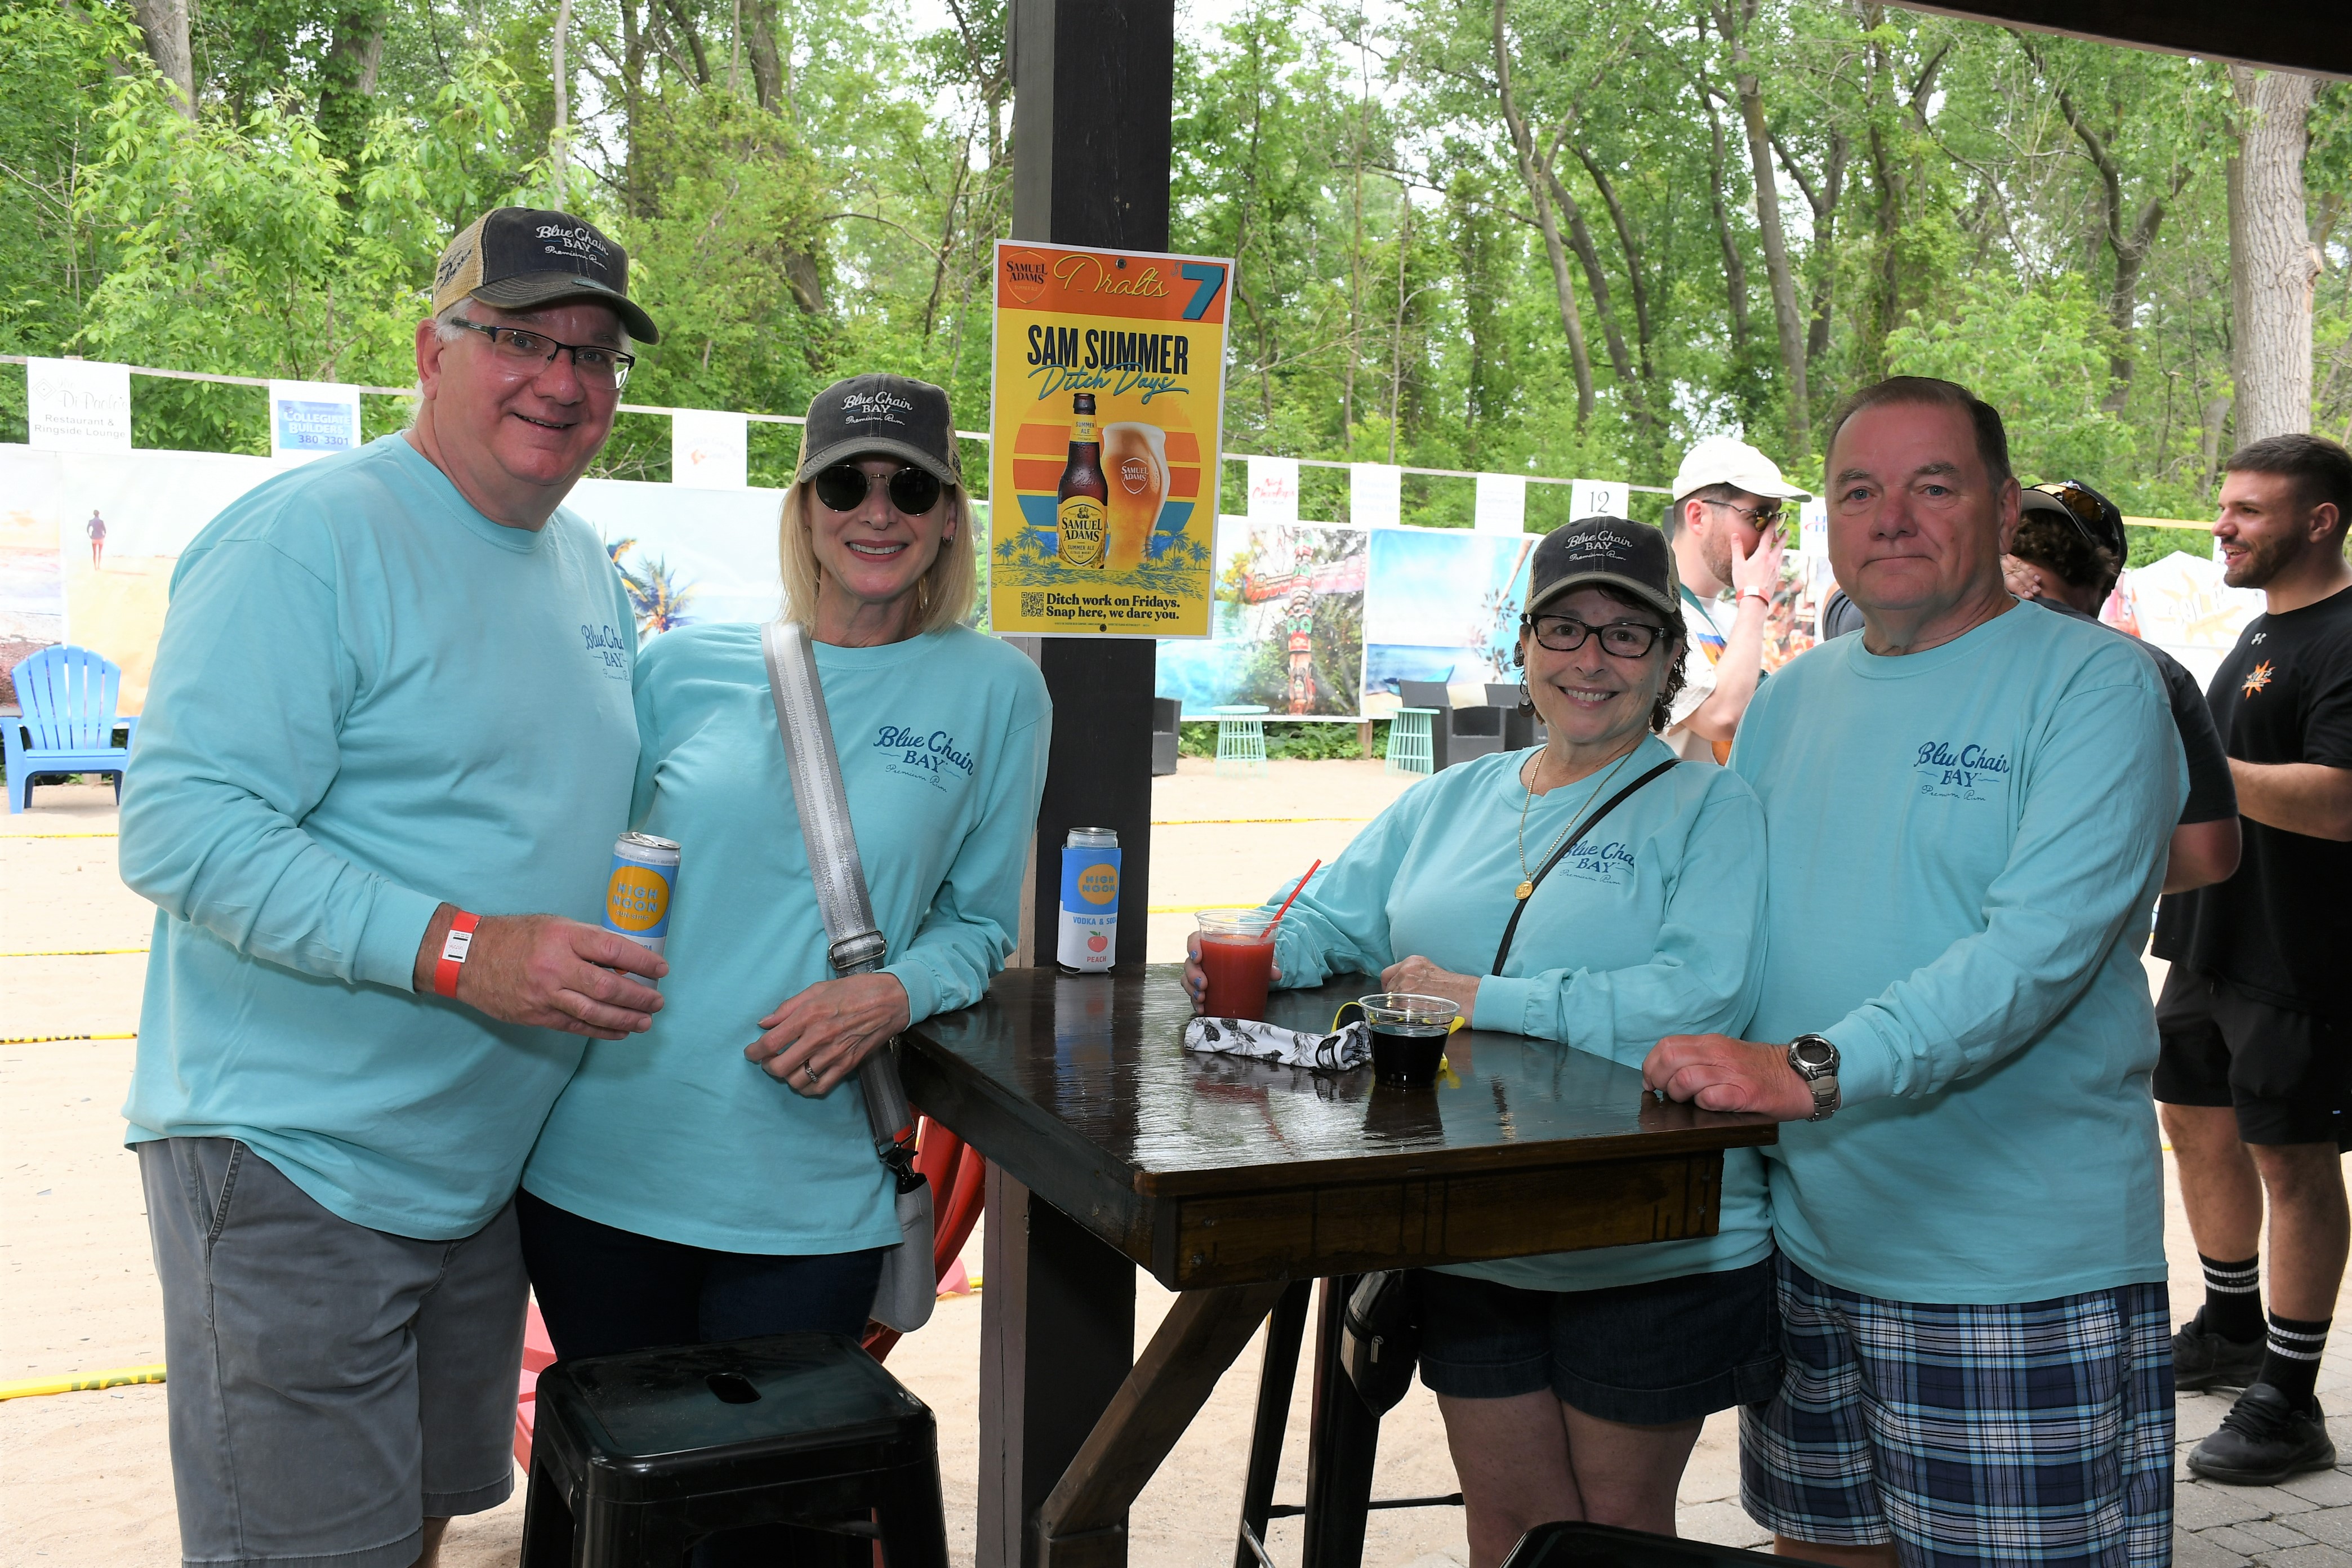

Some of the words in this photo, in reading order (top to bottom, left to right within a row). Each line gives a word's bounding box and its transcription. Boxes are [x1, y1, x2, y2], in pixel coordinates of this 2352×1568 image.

[535, 224, 574, 238] Blue
[574, 228, 609, 256] Chair
[562, 237, 591, 253] BAY
[545, 246, 589, 260] Premium
[589, 254, 608, 270] Rum
[1006, 261, 1048, 275] SAMUEL
[1054, 254, 1170, 297] Drafts
[1009, 272, 1044, 284] ADAMS
[1027, 324, 1079, 368] SAM
[1085, 328, 1189, 375] SUMMER
[1028, 363, 1112, 400] Ditch
[1104, 362, 1190, 404] Days
[841, 392, 874, 410] Blue
[875, 391, 913, 411] Chair
[862, 404, 892, 414] BAY
[45, 414, 104, 426] Restaurant
[284, 411, 352, 425] COLLEGIATE
[845, 415, 883, 425] Premium
[884, 414, 906, 426] Rum
[34, 424, 82, 435] Ringside
[86, 427, 126, 439] Lounge
[289, 422, 344, 435] BUILDERS
[1121, 465, 1149, 476] SAMUEL
[1122, 473, 1147, 482] ADAMS
[1590, 491, 1610, 514] 12
[1061, 517, 1103, 531] SAMUEL
[1063, 531, 1099, 542] ADAMS
[1565, 532, 1596, 549] Blue
[1597, 531, 1633, 547] Chair
[1584, 541, 1612, 551] BAY
[1569, 552, 1605, 562] Premium
[1606, 550, 1627, 561] Rum
[1046, 593, 1079, 605] Ditch
[1083, 594, 1112, 606] work
[1115, 597, 1129, 607] on
[1132, 595, 1180, 609] Fridays.
[1046, 605, 1076, 620] Snap
[1078, 606, 1107, 619] here,
[1109, 609, 1124, 618] we
[1126, 607, 1153, 619] dare
[1155, 610, 1180, 622] you.
[581, 624, 606, 650] Blue
[603, 651, 623, 667] BAY
[873, 725, 925, 747] Blue
[928, 730, 973, 776] Chair
[1961, 744, 2010, 773] Chair
[902, 750, 945, 773] BAY
[885, 764, 926, 781] Premium
[929, 775, 947, 793] Rum
[1940, 768, 1979, 787] BAY
[1963, 789, 1986, 801] Rum
[1575, 858, 1617, 874] BAY
[1086, 875, 1115, 884] HIGH
[1559, 869, 1597, 881] Premium
[1600, 874, 1622, 885] Rum
[617, 881, 658, 901] HIGH
[1083, 884, 1117, 893] NOON
[612, 894, 658, 913] NOON
[616, 909, 630, 919] SUN
[1073, 916, 1096, 925] VODKA
